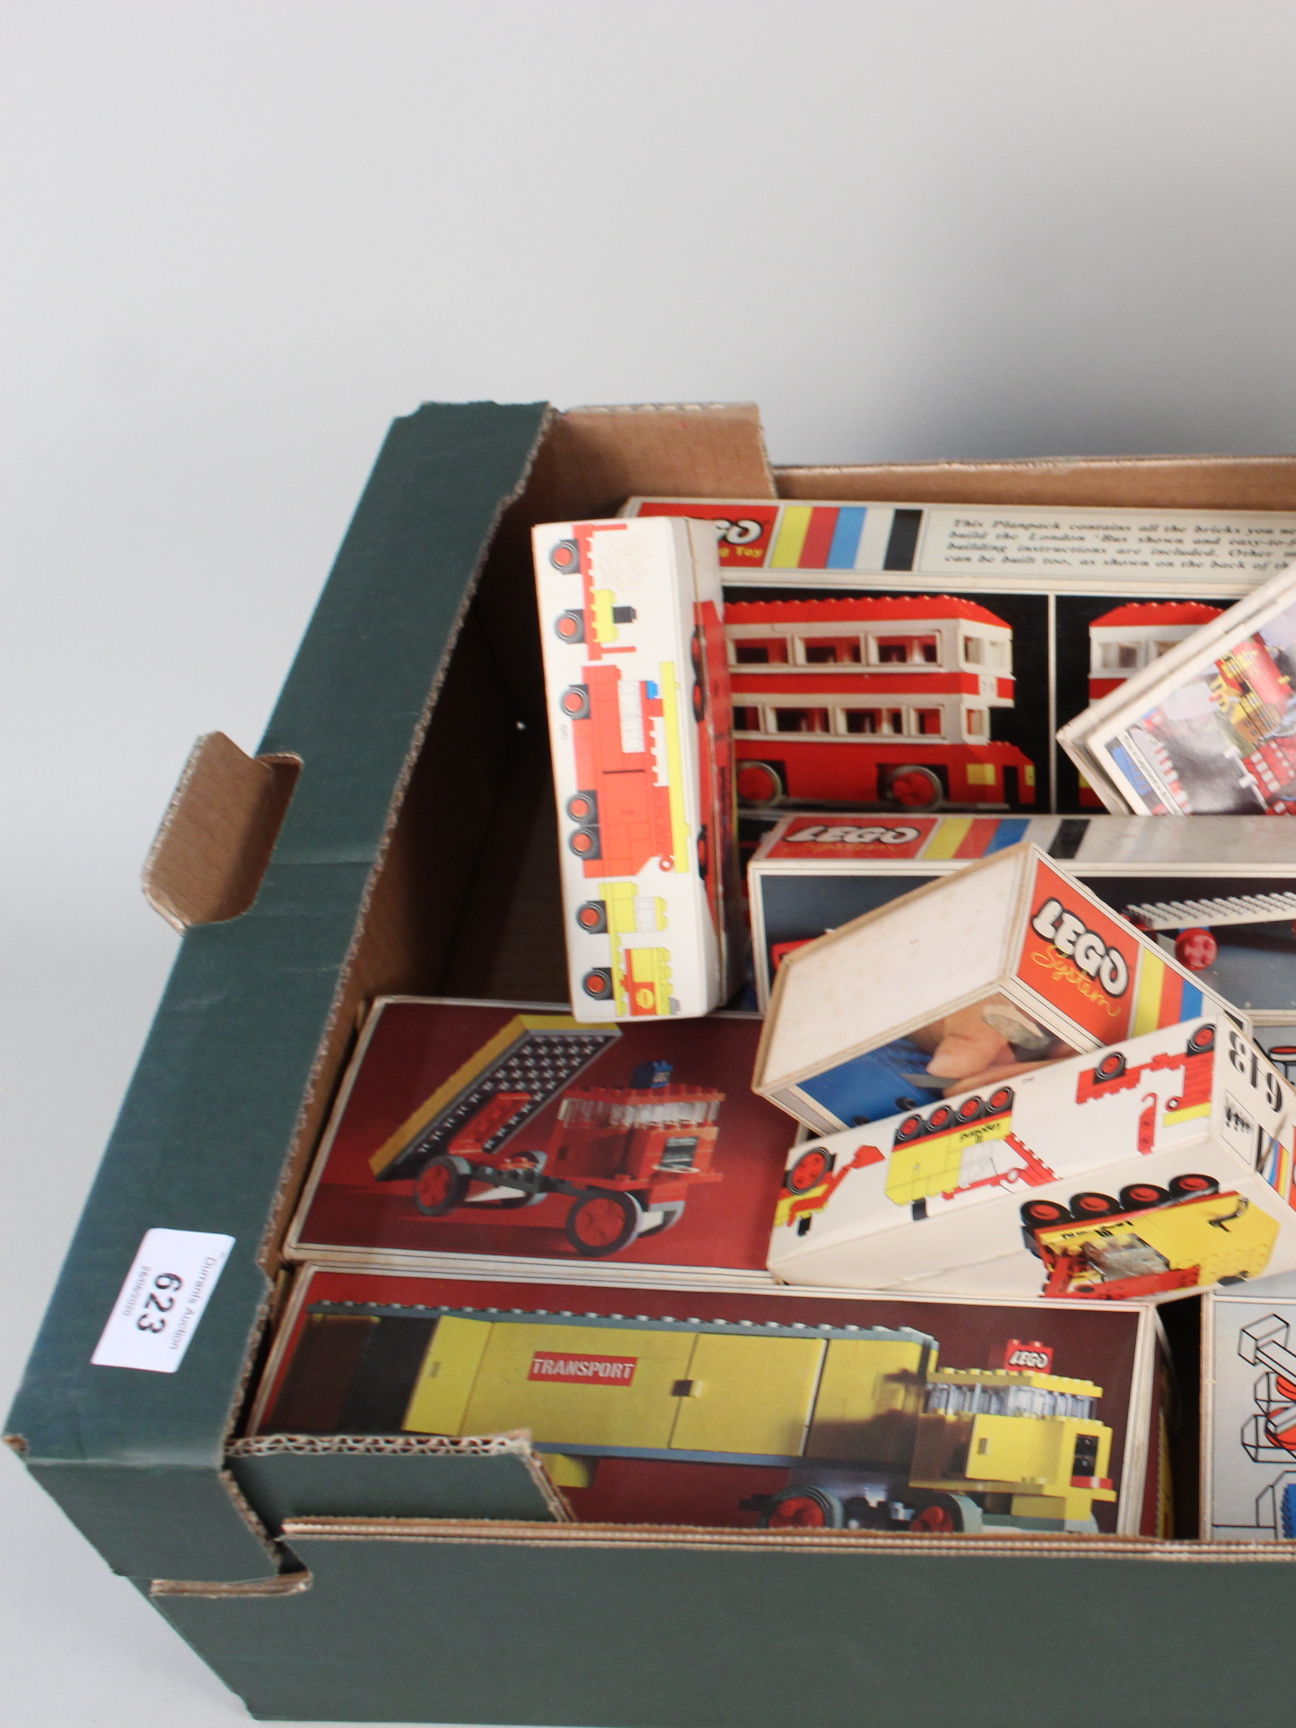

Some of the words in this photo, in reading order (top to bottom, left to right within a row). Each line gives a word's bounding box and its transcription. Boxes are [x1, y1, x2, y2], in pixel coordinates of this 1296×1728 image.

[996, 532, 1019, 540] the
[1164, 524, 1186, 533] the
[782, 825, 921, 844] LEGO
[1031, 897, 1129, 998] LEGO
[1031, 945, 1122, 1017] System
[189, 1256, 216, 1304] Durrants
[136, 1272, 183, 1334] 623
[169, 1307, 197, 1350] Auction
[532, 1358, 635, 1379] TRANSPORT
[1008, 1349, 1049, 1368] LEGO
